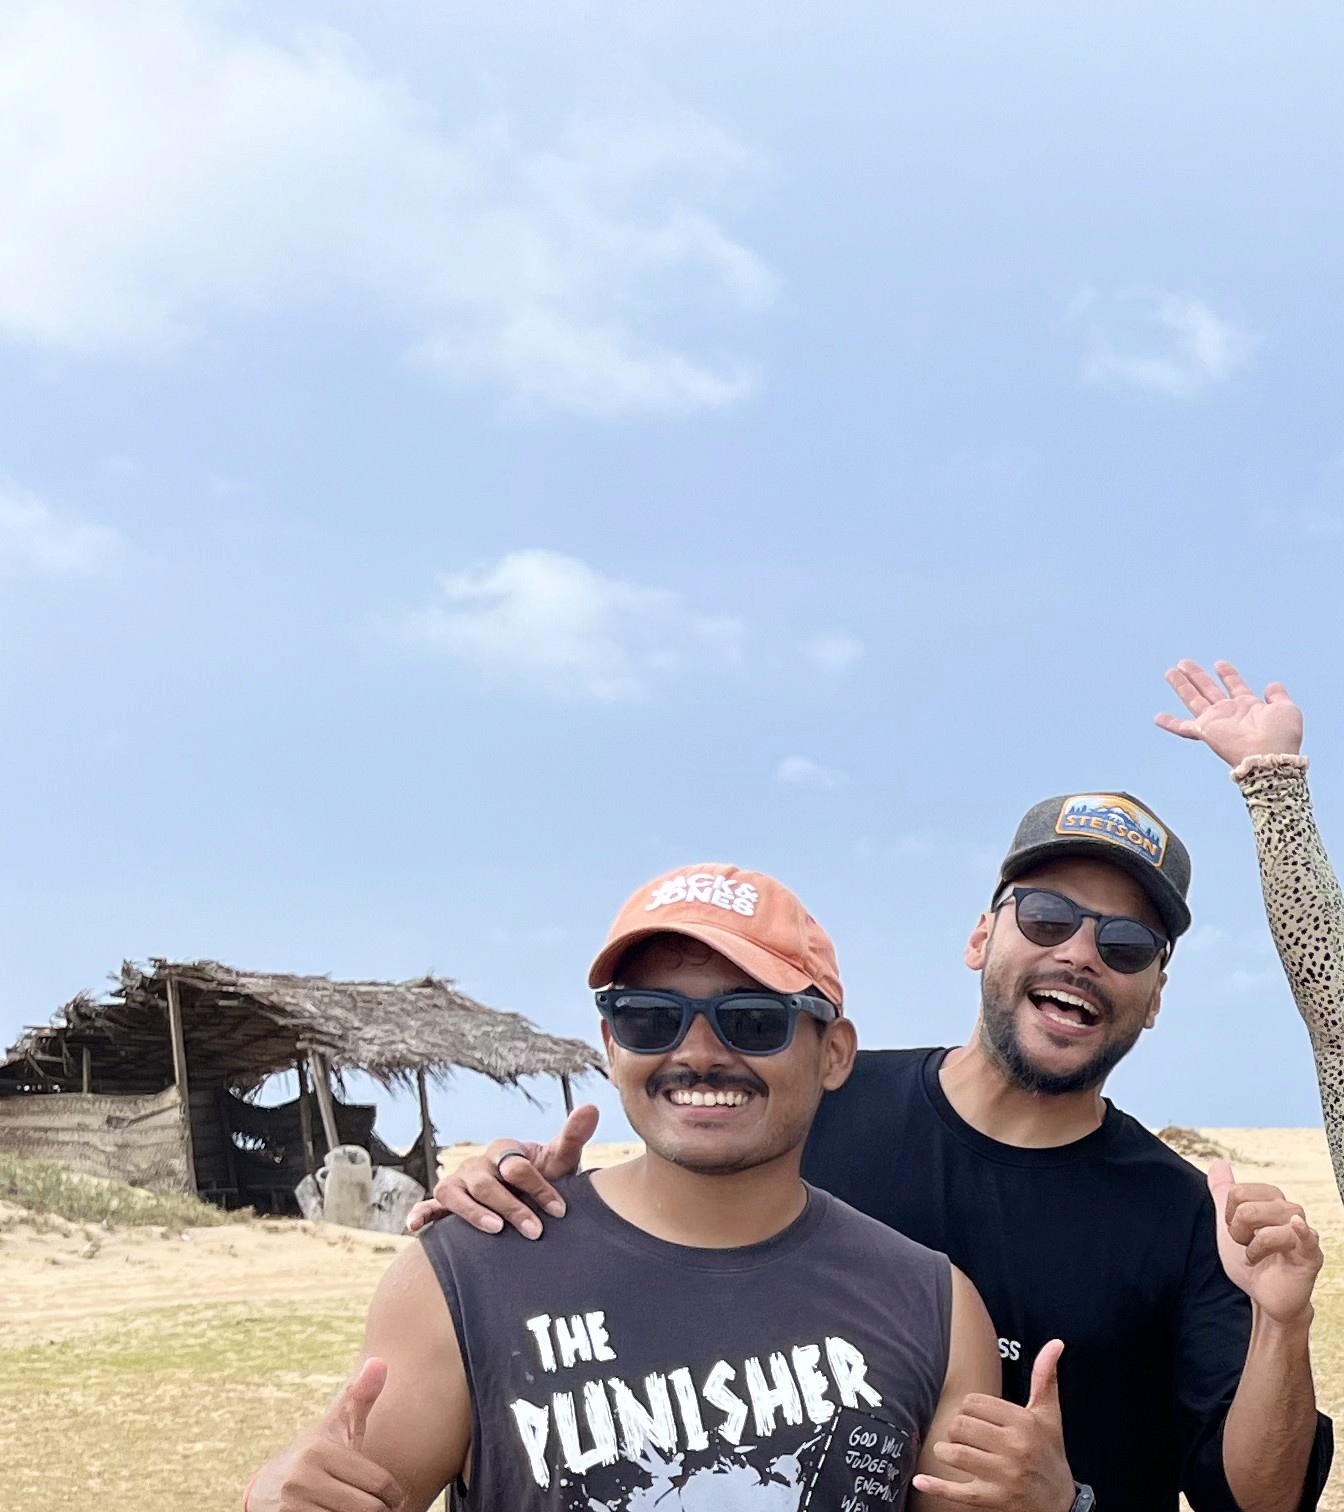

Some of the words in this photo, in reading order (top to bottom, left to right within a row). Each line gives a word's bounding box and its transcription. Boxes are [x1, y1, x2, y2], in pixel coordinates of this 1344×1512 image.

[1064, 813, 1158, 856] STETSON
[644, 886, 755, 917] JONES
[526, 1311, 617, 1372] THE
[510, 1336, 883, 1488] PUNISHER
[849, 1425, 878, 1447] GOD
[845, 1450, 888, 1474] JUDGE
